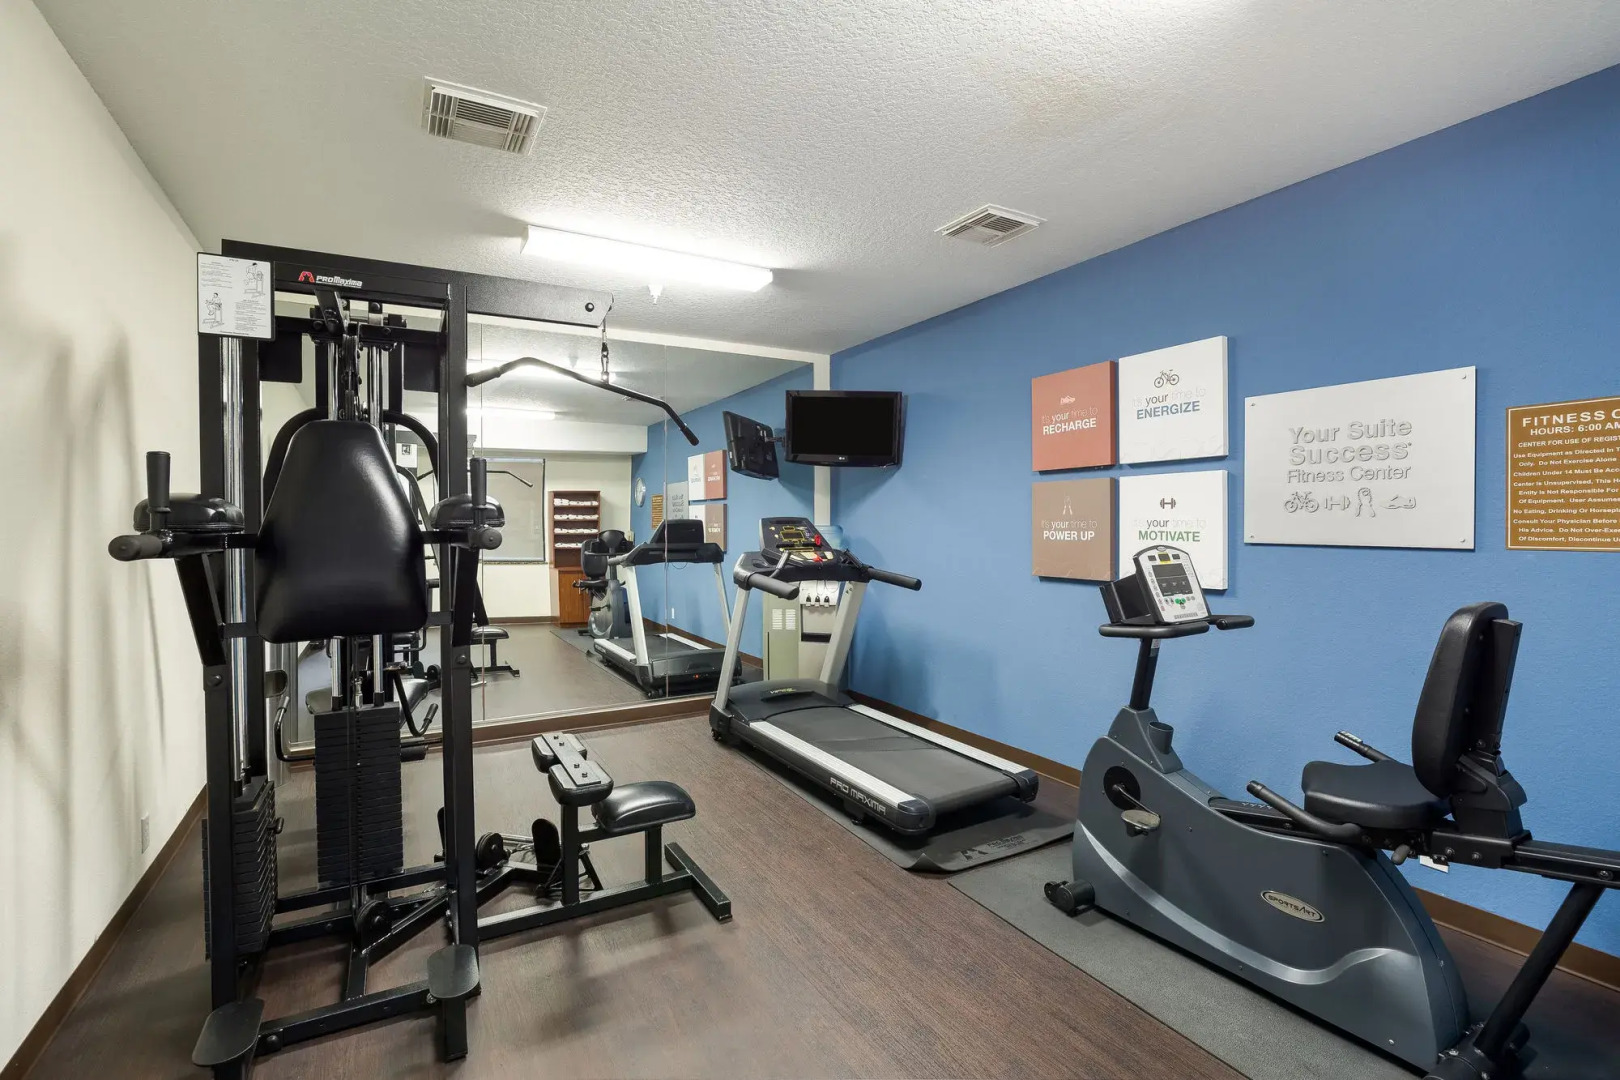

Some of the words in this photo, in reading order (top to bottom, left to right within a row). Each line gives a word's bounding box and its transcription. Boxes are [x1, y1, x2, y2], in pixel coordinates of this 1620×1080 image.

[1145, 393, 1169, 407] your
[1136, 400, 1201, 420] ENERGIZE
[1051, 412, 1070, 425] your
[1522, 410, 1606, 428] FITNESS
[1042, 417, 1097, 436] RECHARGE
[1288, 426, 1341, 445] Your
[1346, 418, 1413, 440] Suite
[1530, 425, 1575, 436] HOURS:
[1577, 423, 1602, 433] 6:00
[1518, 440, 1546, 448] CENTER
[1564, 437, 1580, 445] USE
[1527, 451, 1563, 459] Equipment
[1574, 447, 1605, 455] Directed
[1287, 468, 1345, 484] Fitness
[1350, 465, 1412, 481] Center
[1051, 521, 1069, 530] your
[1146, 519, 1170, 530] your
[1043, 530, 1078, 541] POWER
[1080, 530, 1095, 541] UP
[1138, 529, 1201, 543] MOTIVATE
[830, 776, 849, 794] PRO
[850, 788, 887, 816] MAXIMA
